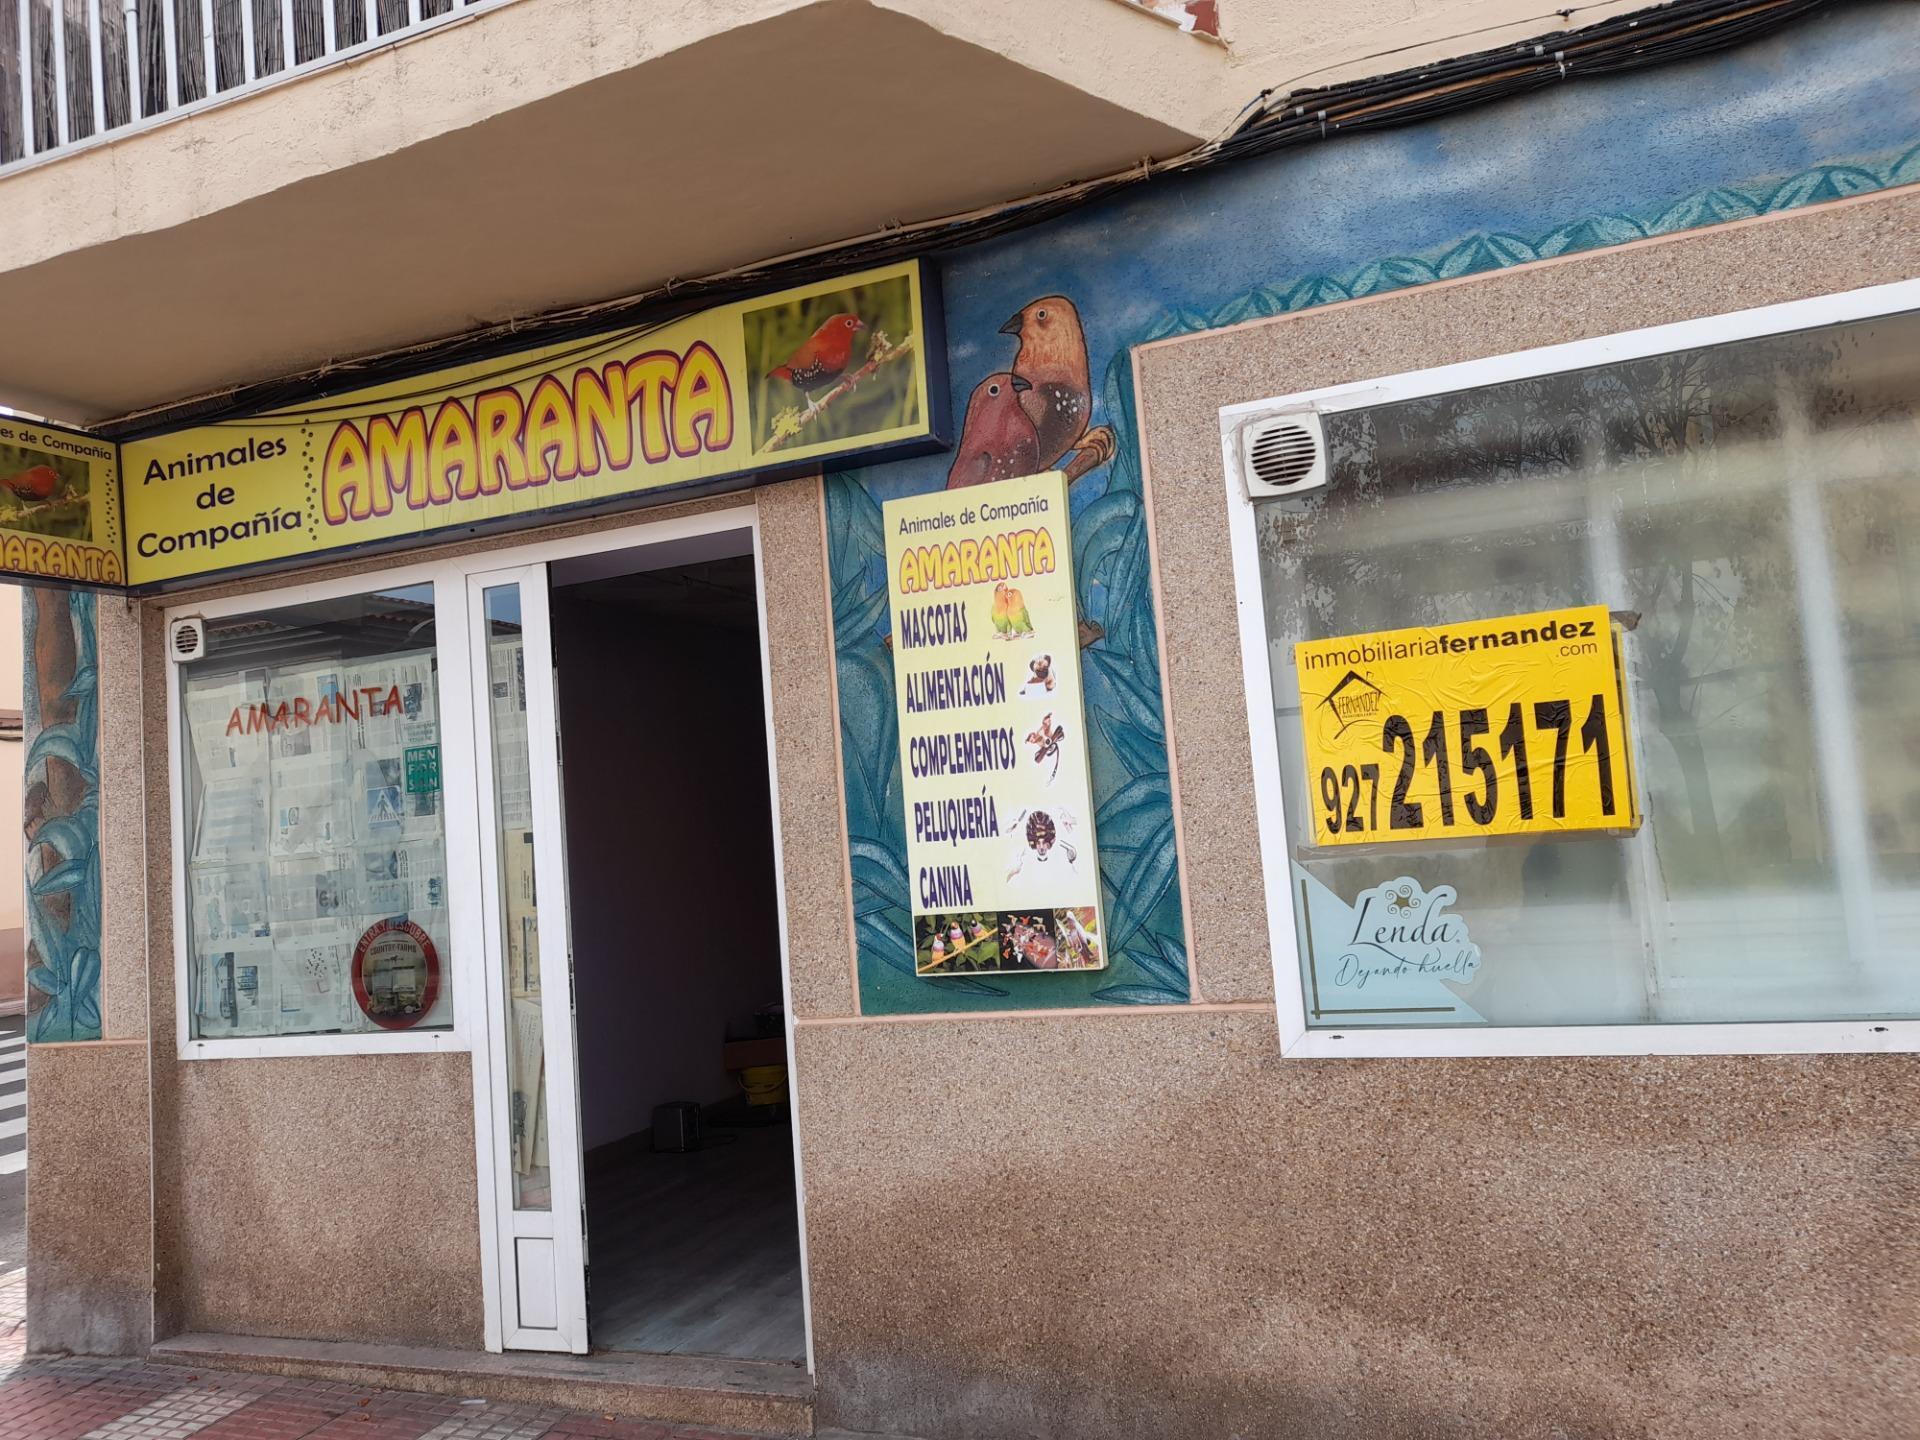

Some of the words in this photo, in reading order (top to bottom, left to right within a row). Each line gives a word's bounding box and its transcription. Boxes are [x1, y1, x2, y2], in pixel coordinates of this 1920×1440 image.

[19, 430, 37, 444] de
[42, 434, 112, 460] Compañía
[322, 340, 734, 526] AMARANTA
[143, 437, 287, 485] Animales
[196, 483, 235, 510] de
[899, 511, 955, 535] Animales
[959, 508, 976, 525] de
[980, 496, 1049, 522] Compañía
[137, 507, 302, 557] Compañía
[899, 527, 1056, 594] AMARANTA
[900, 601, 968, 649] MASCOTAS
[1304, 620, 1596, 671] inmobiliariafernandez
[1555, 640, 1598, 658] .com
[906, 651, 1006, 713] ALIMENTACIÓN
[1338, 691, 1380, 714] FERNANDEZ
[225, 685, 404, 737] AMARANTA
[407, 748, 436, 762] MEN
[910, 726, 1016, 778] COMPLEMENTOS
[1321, 762, 1380, 834] 927
[1382, 694, 1616, 831] 215171
[914, 784, 999, 847] PELUQUERÍA
[920, 864, 973, 909] CANINA
[1418, 950, 1480, 976] huella
